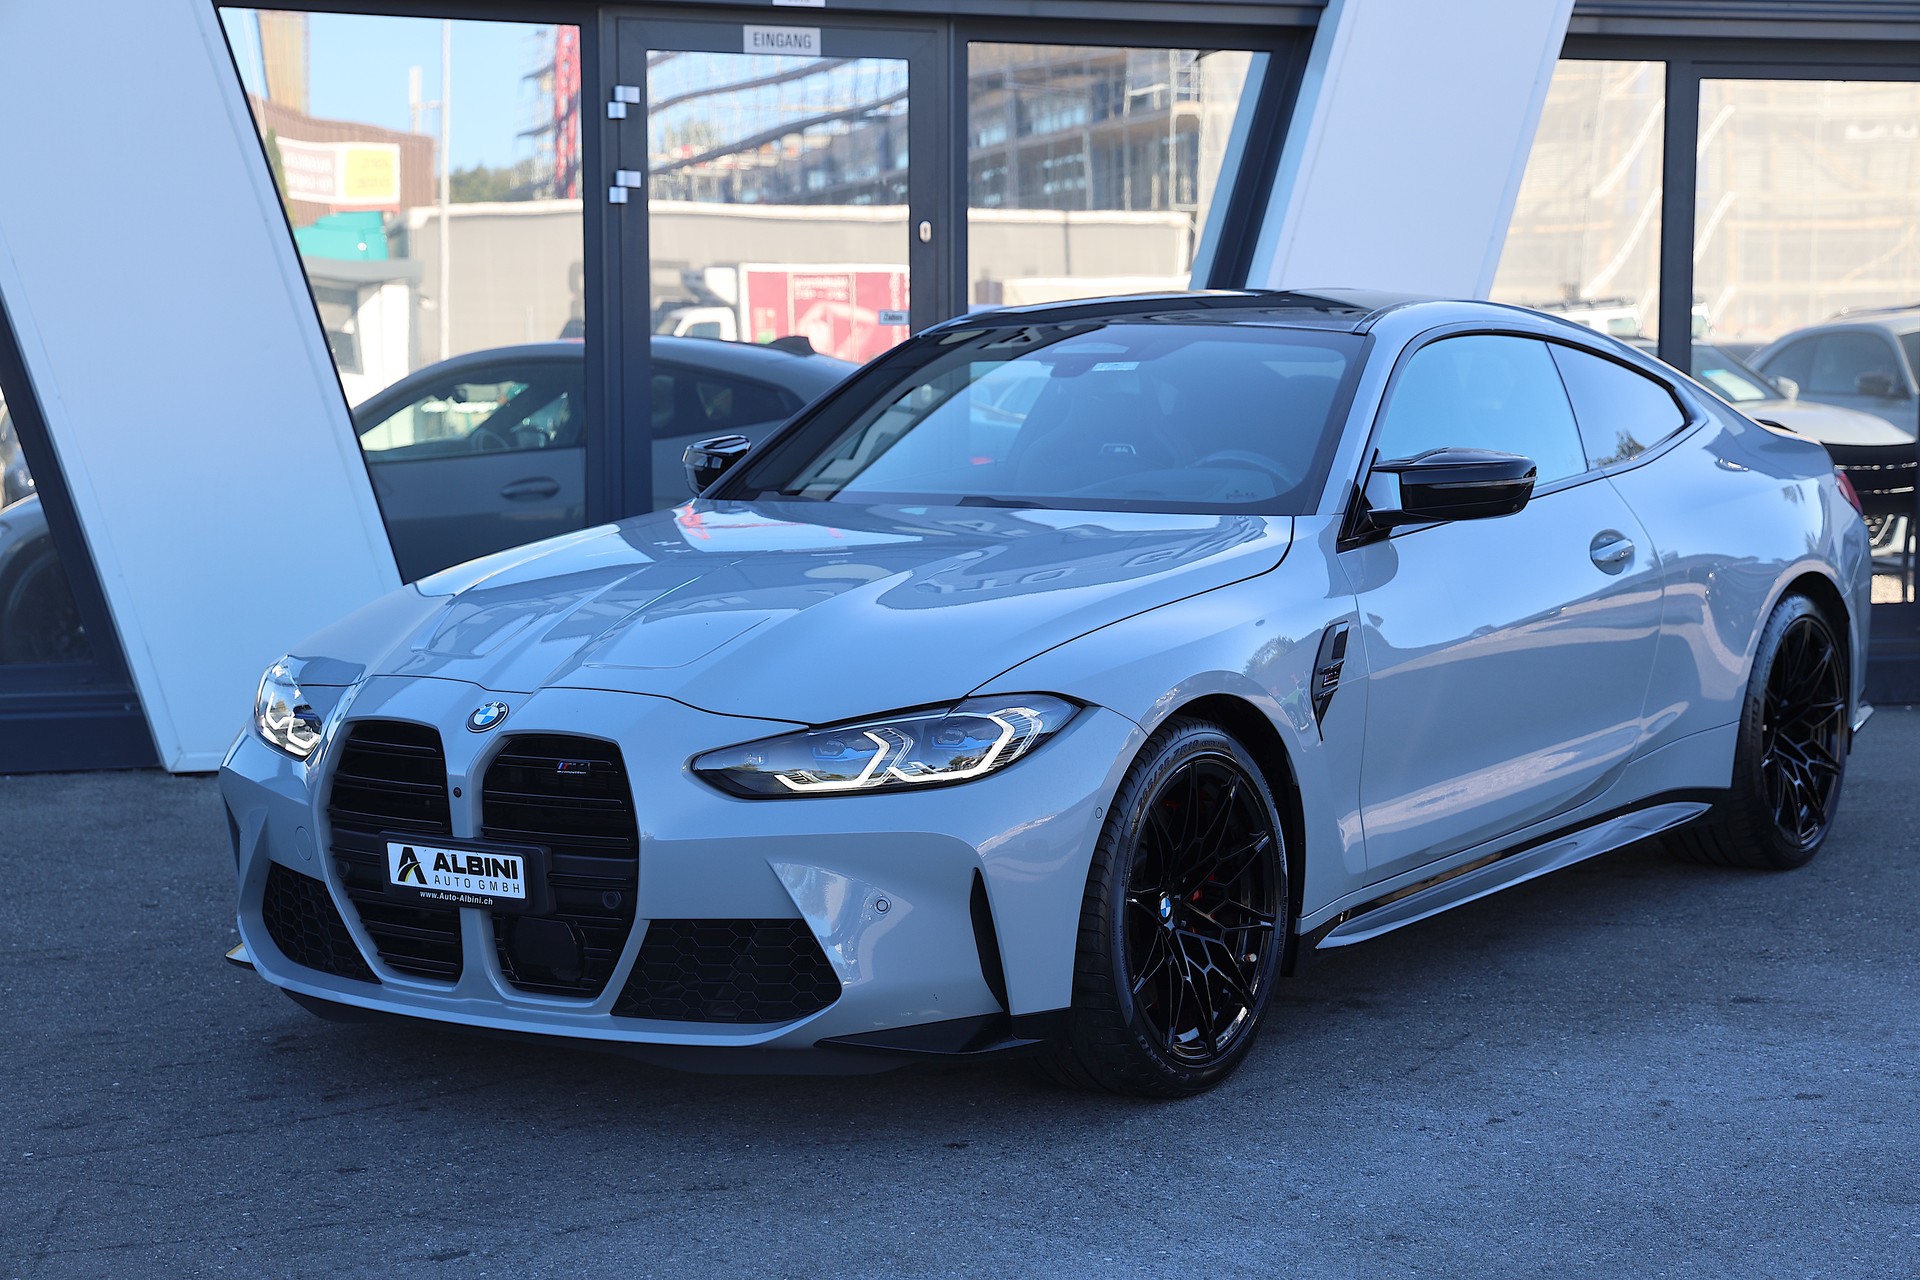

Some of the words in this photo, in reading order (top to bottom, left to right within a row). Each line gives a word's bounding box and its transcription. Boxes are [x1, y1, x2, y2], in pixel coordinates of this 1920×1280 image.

[752, 31, 812, 50] EINGANG
[433, 852, 519, 880] ALBINI
[434, 874, 471, 889] AUTO
[478, 879, 520, 894] GMBH
[419, 890, 494, 906] www.Auto-Albini.ch
